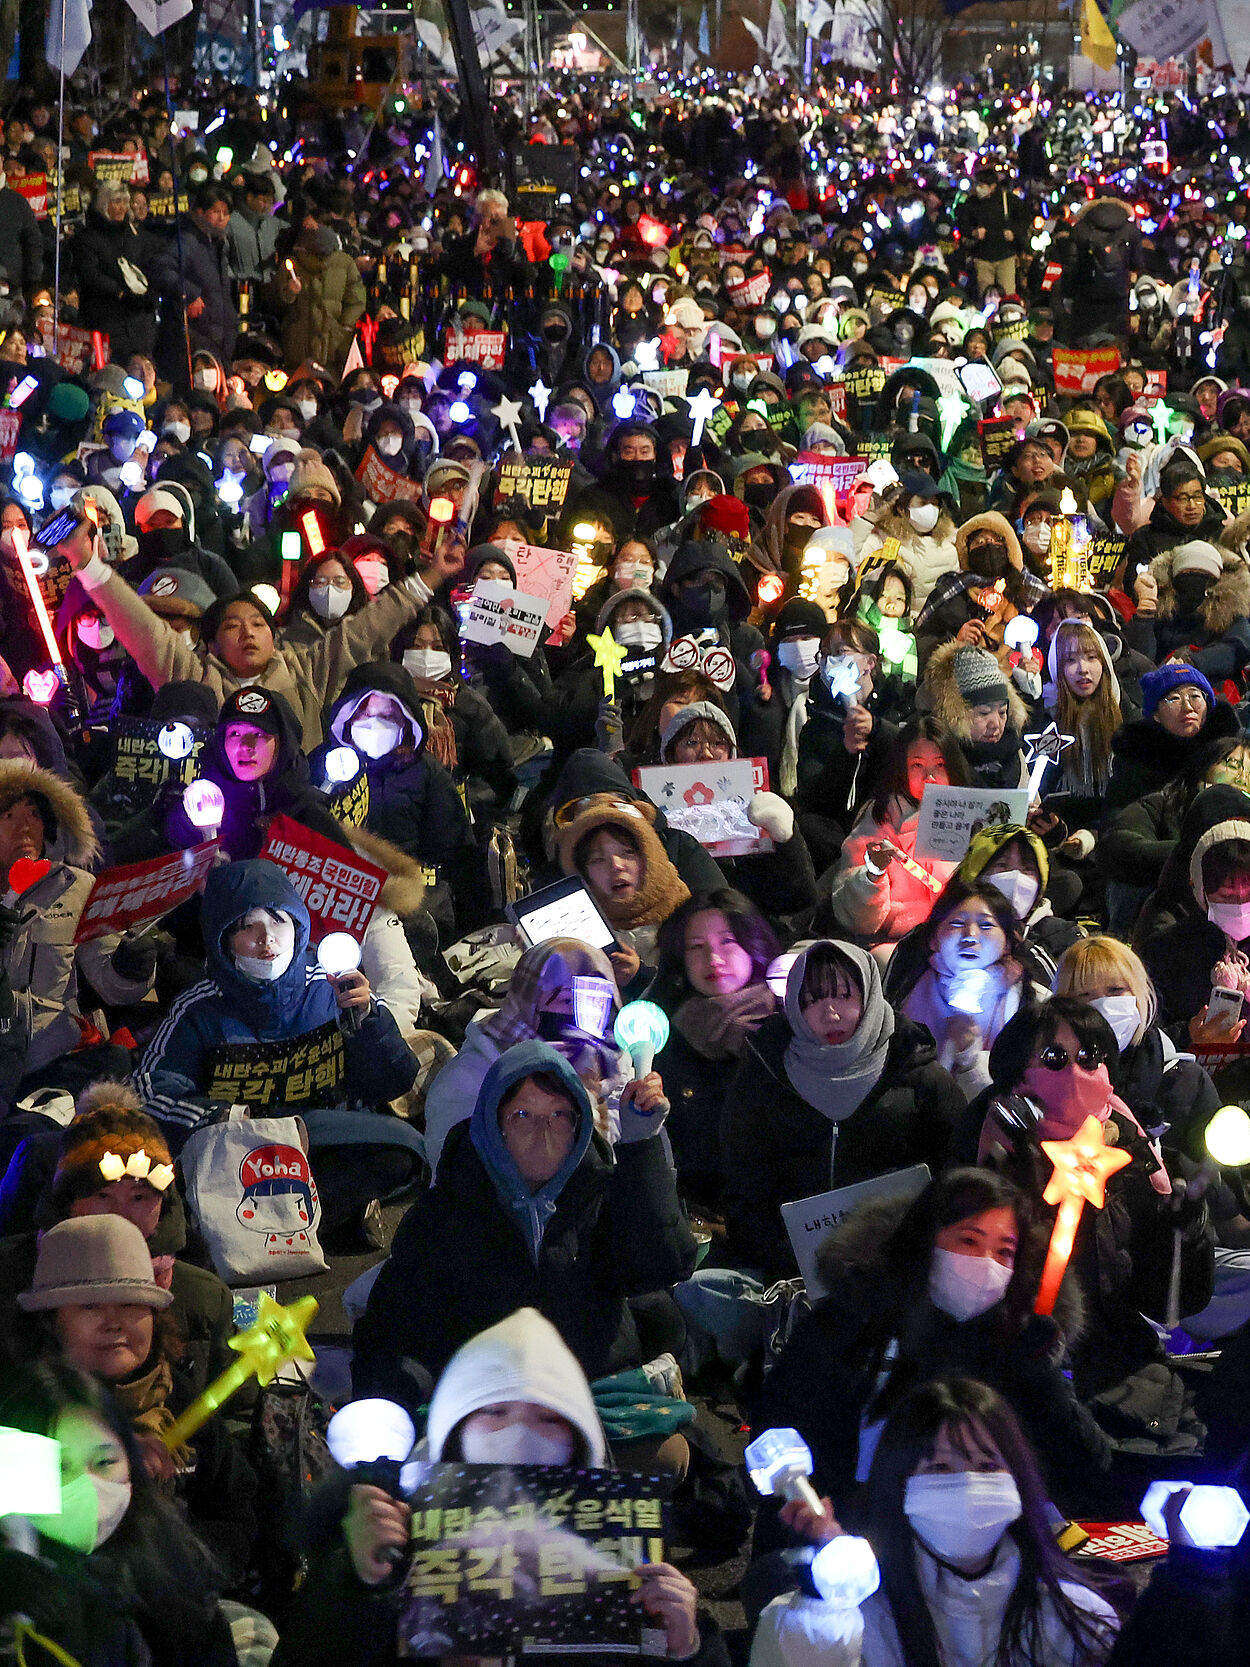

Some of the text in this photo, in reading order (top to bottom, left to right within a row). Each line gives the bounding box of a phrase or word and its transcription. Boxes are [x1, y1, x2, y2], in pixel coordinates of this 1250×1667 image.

[500, 478, 570, 506] 즉각 탄핵
[267, 839, 378, 897] 내란동조 국민의힘
[280, 864, 372, 932] 체하라!
[215, 1031, 345, 1079] 내란수괴 윤석열
[284, 1052, 345, 1103] 탄핵!
[247, 1155, 302, 1179] Yoha
[411, 1498, 664, 1543] 내란수괴 윤석열
[411, 1536, 665, 1605] 즉각 탄핵!
